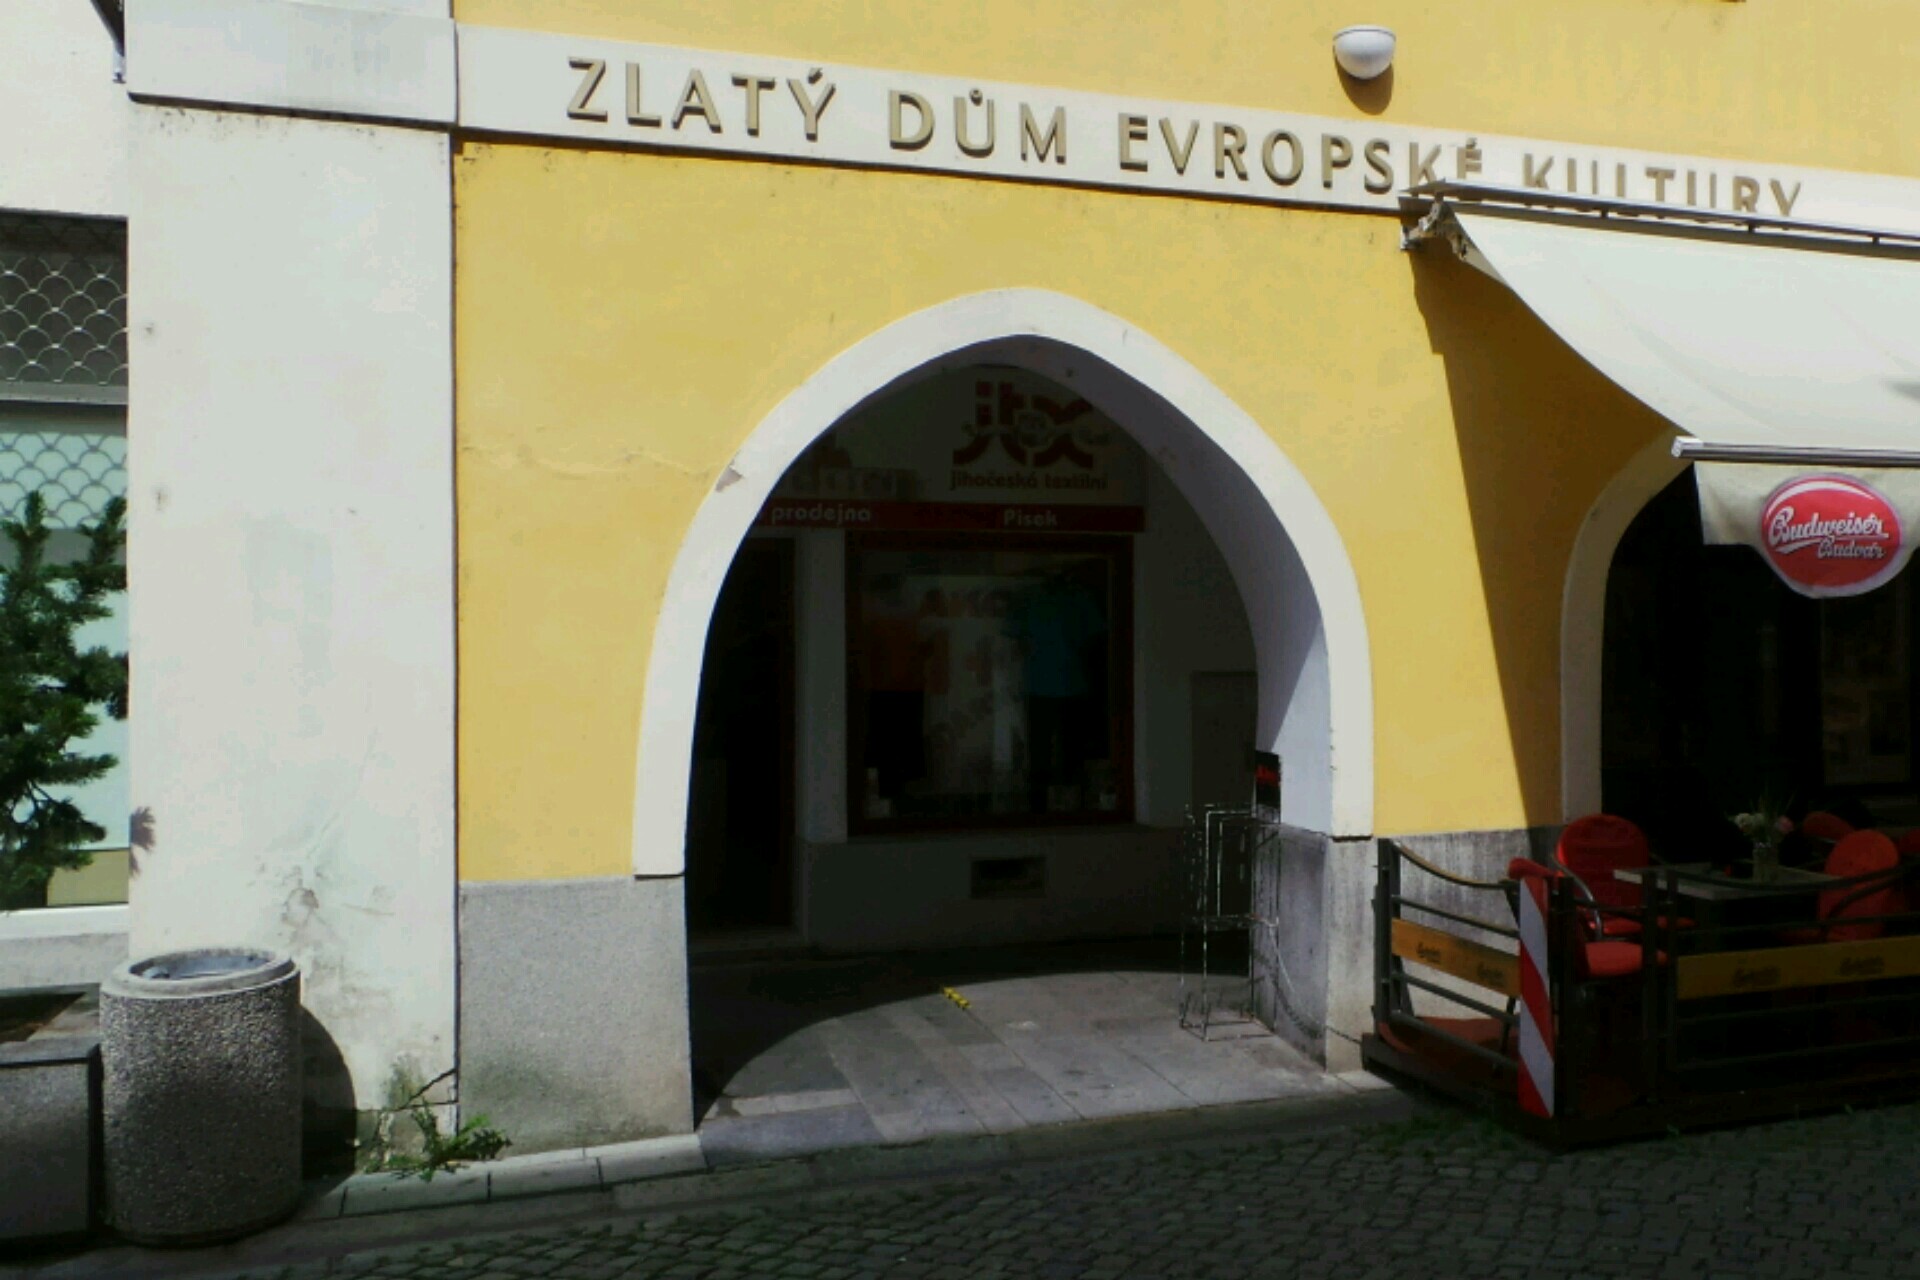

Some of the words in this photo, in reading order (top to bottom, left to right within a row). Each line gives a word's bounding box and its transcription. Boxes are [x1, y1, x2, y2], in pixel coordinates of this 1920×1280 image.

[567, 59, 836, 141] ZLATÝ
[889, 89, 1067, 164] DŮM
[1119, 113, 1484, 194] EVROPSKÉ
[771, 503, 872, 526] prodejna
[1769, 506, 1889, 549] Budweiser
